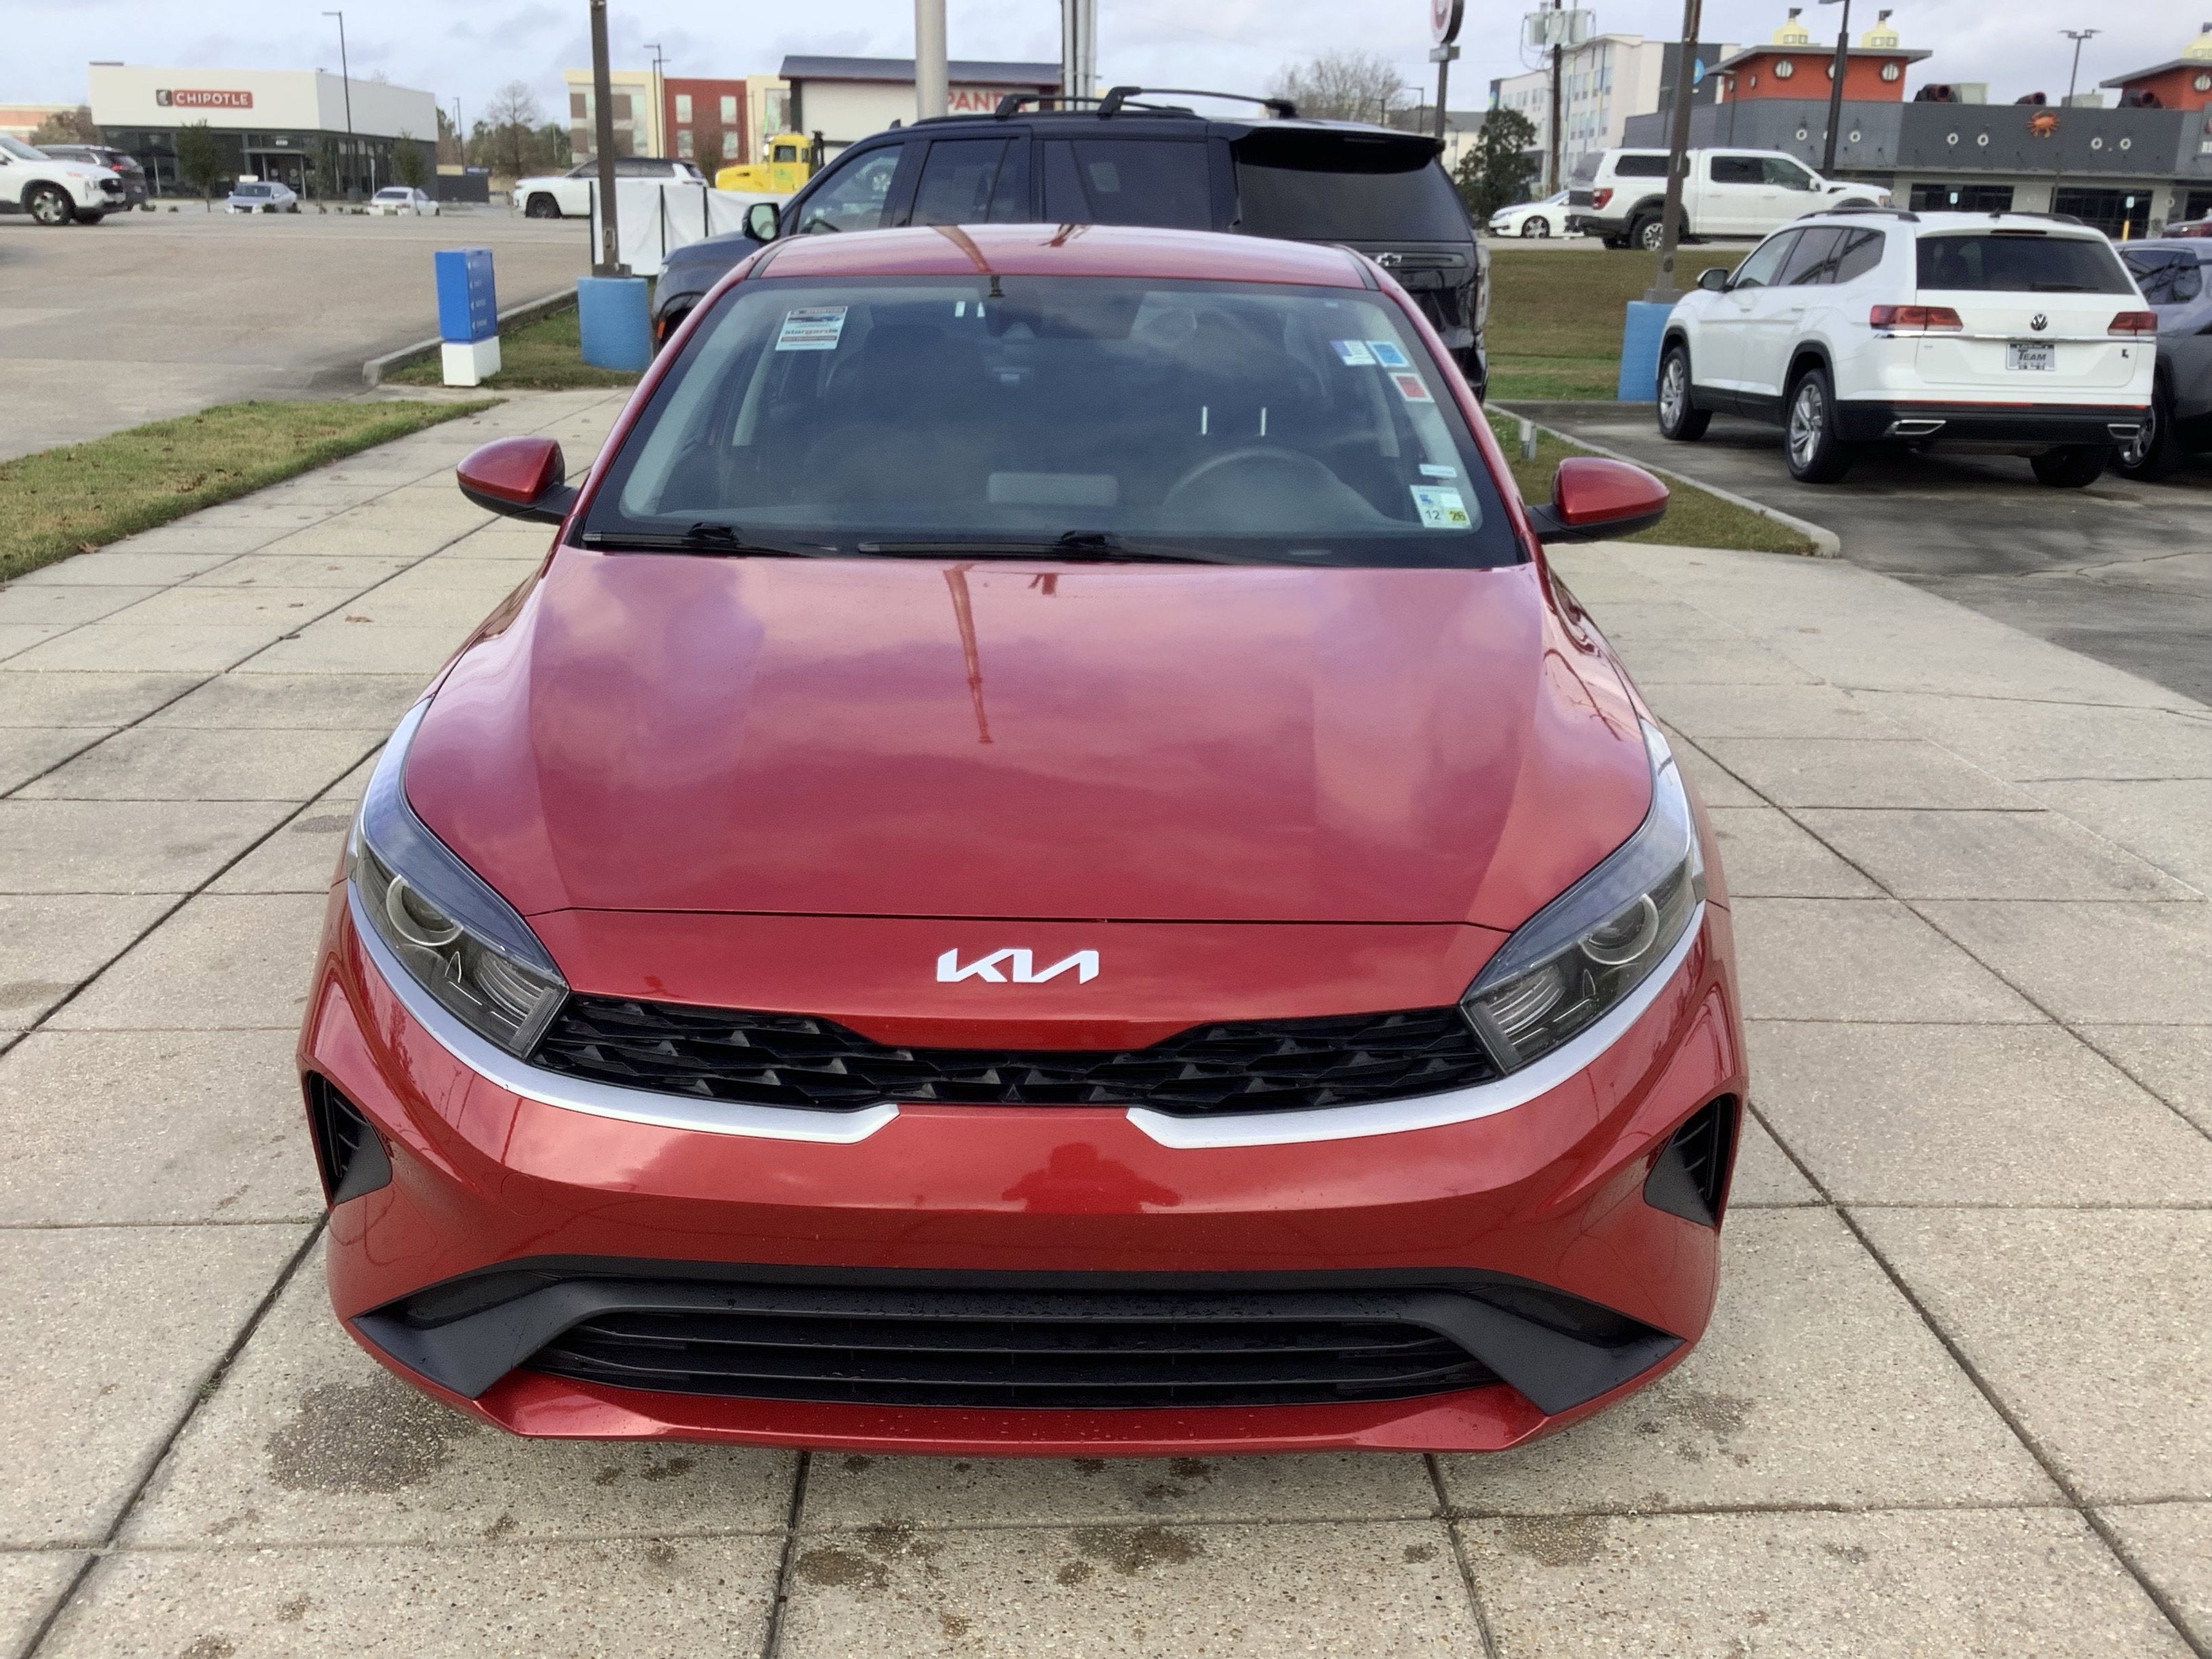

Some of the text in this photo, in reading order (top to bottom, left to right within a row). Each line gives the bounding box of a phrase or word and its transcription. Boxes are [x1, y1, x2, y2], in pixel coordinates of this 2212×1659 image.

[176, 91, 249, 106] CHIPOTLE
[1425, 510, 1441, 520] 12
[937, 947, 1099, 985] KIA
